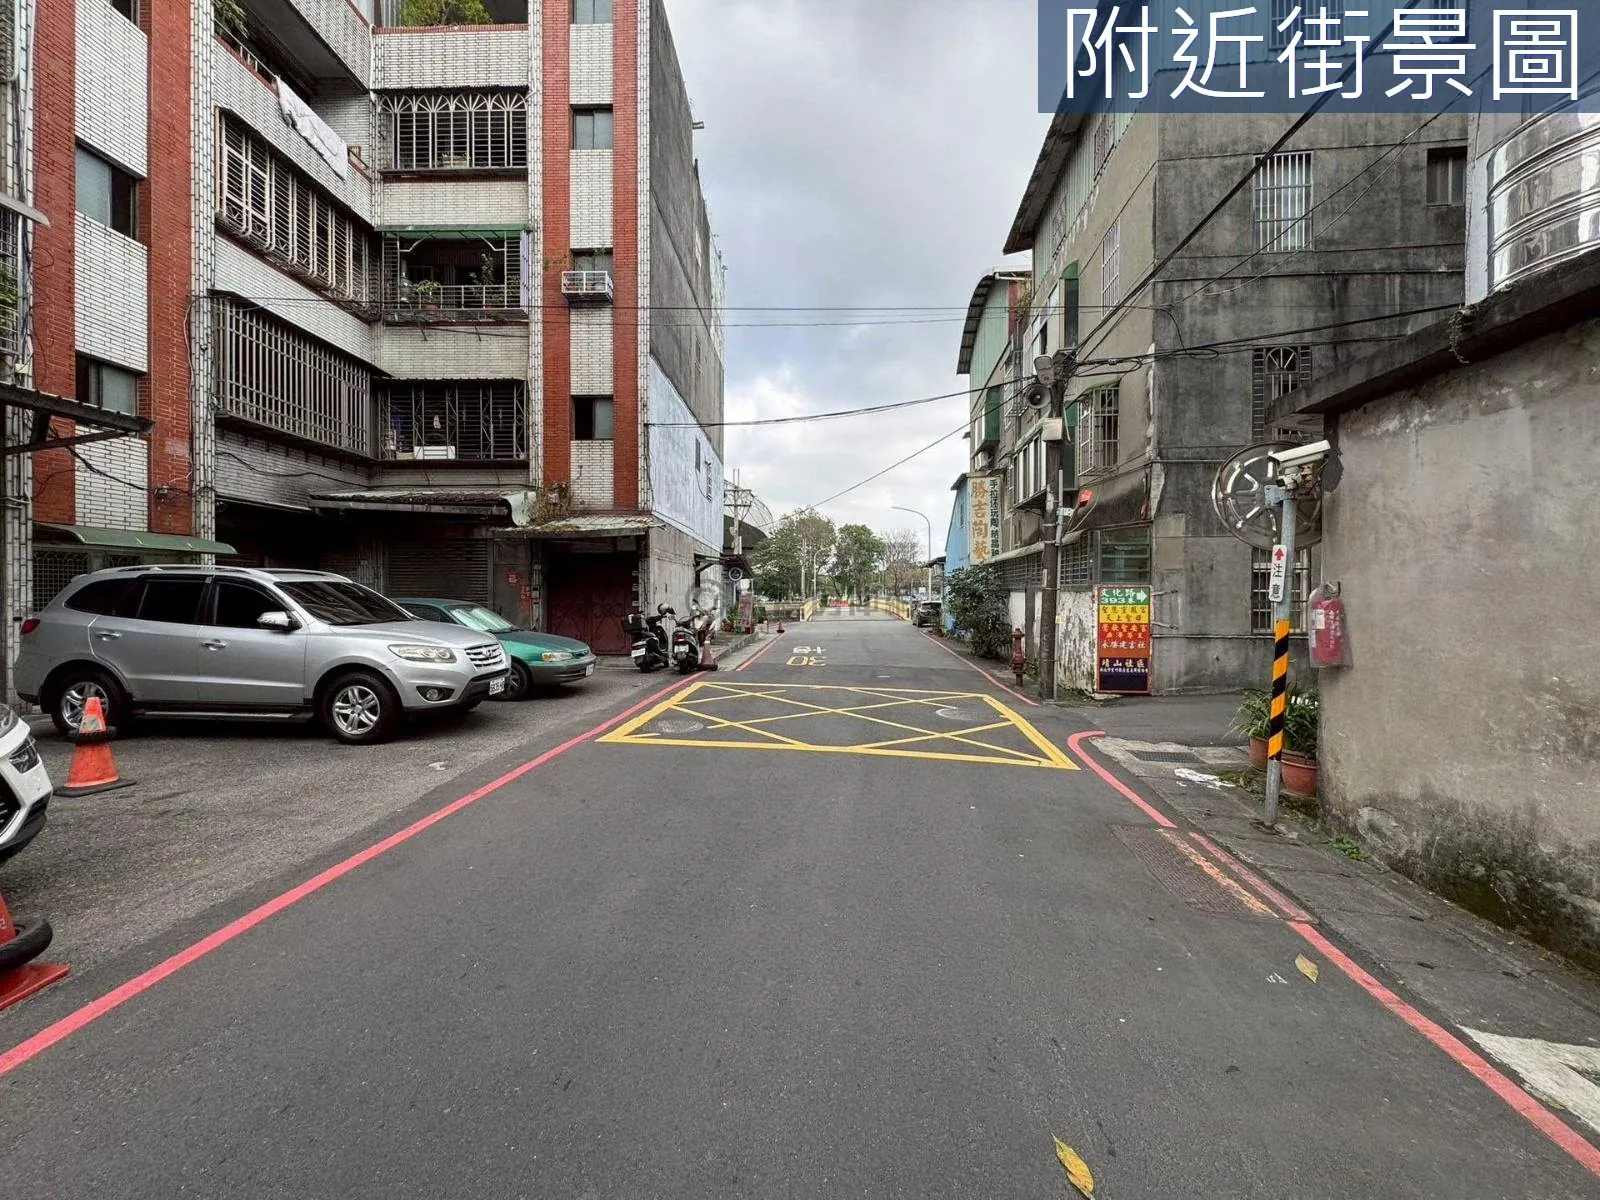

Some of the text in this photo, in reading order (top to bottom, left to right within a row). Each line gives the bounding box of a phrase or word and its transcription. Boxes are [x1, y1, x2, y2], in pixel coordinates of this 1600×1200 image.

[1271, 563, 1283, 599] 注意
[1101, 588, 1136, 597] 文化路
